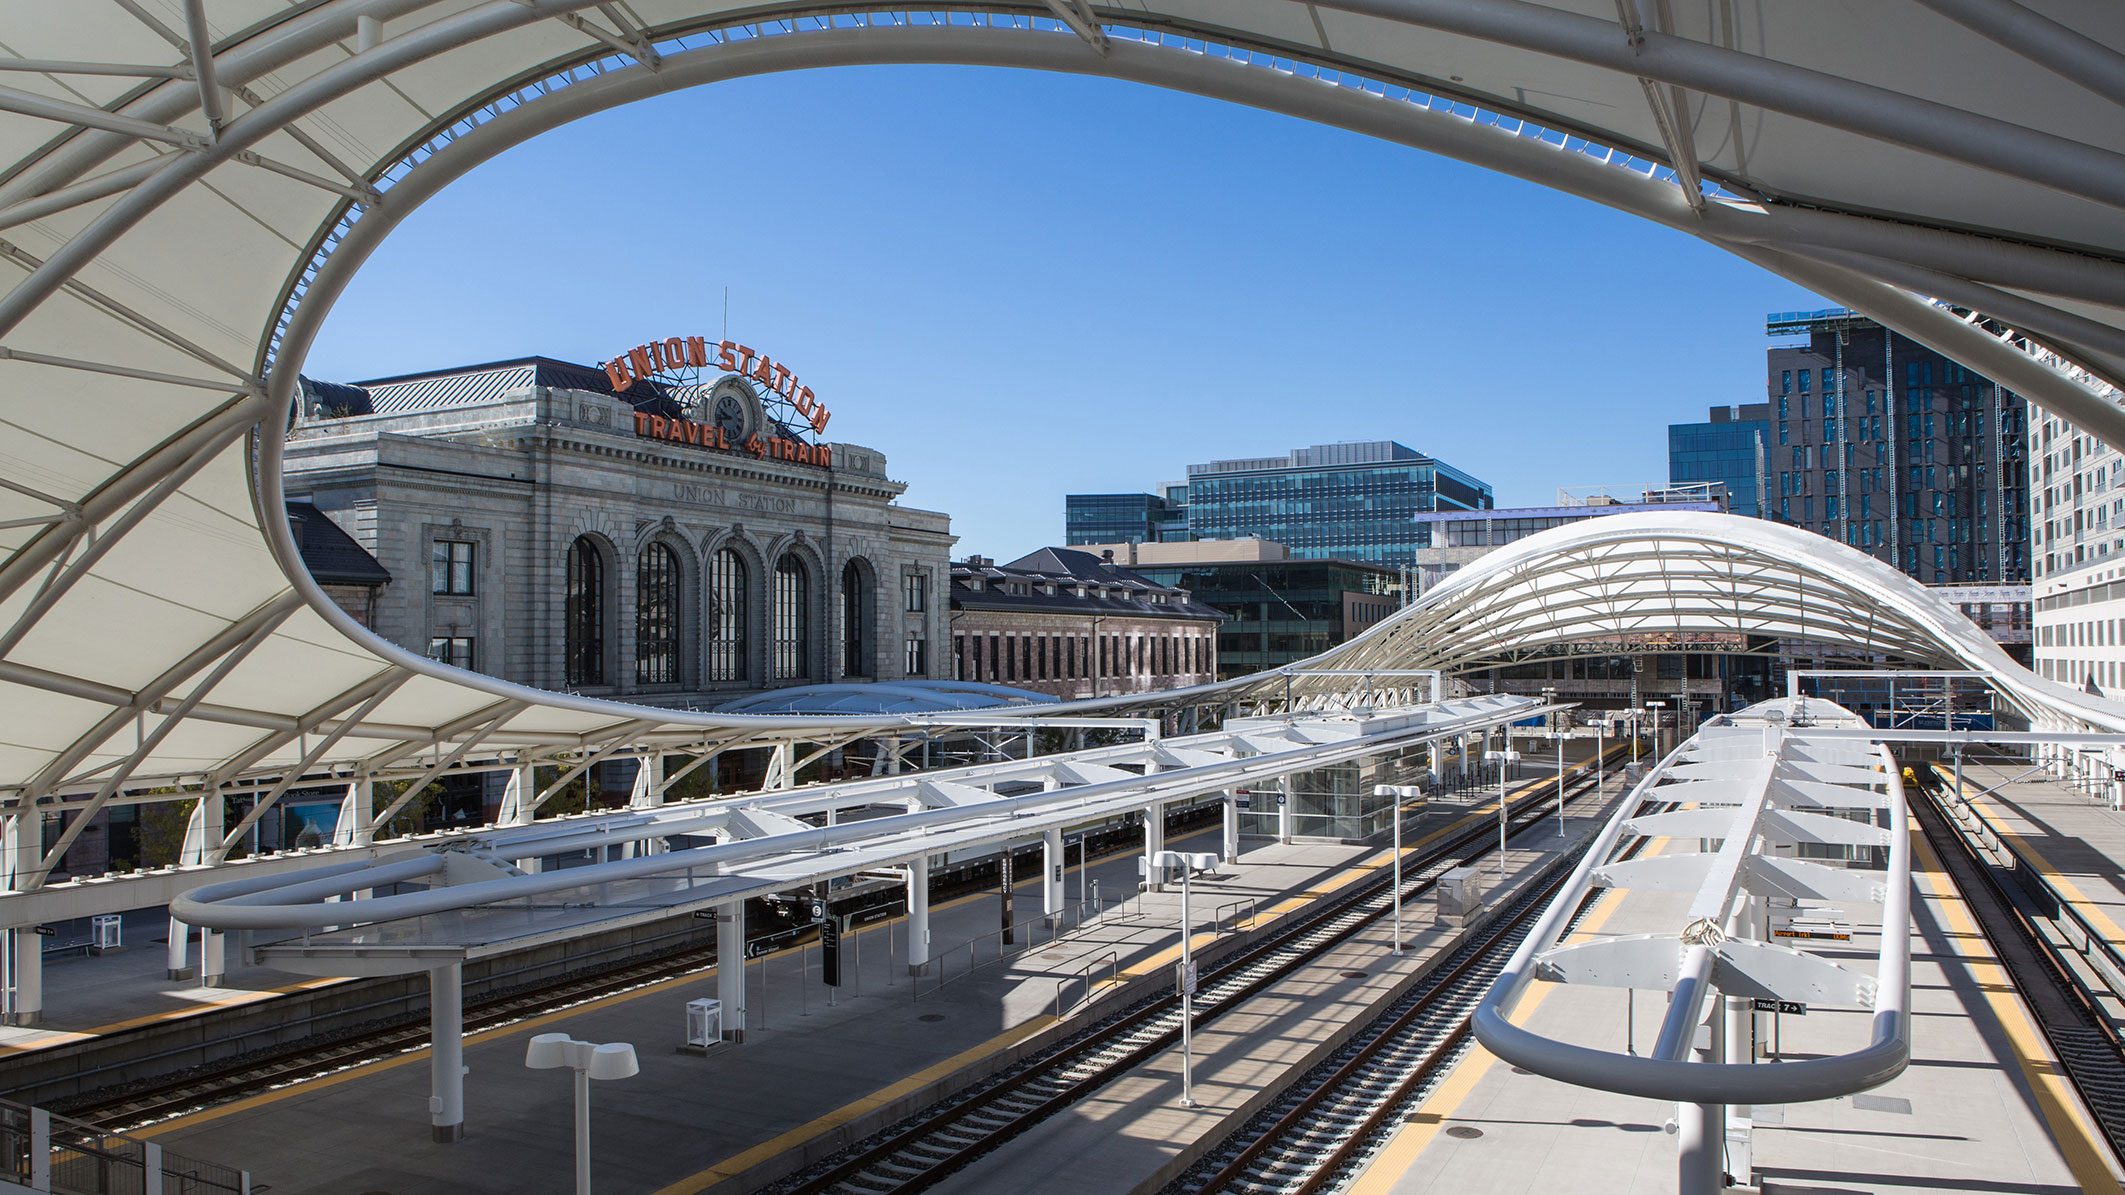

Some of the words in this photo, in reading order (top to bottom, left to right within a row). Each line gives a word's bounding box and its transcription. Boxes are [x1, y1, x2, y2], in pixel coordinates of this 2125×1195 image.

[605, 336, 707, 393] UNION
[719, 340, 832, 435] STATION
[634, 411, 731, 450] TRAVEL
[745, 432, 766, 460] by
[768, 436, 832, 467] TRAIN
[673, 483, 725, 505] UNION
[738, 493, 795, 514] STATION
[1783, 1003, 1790, 1011] 7
